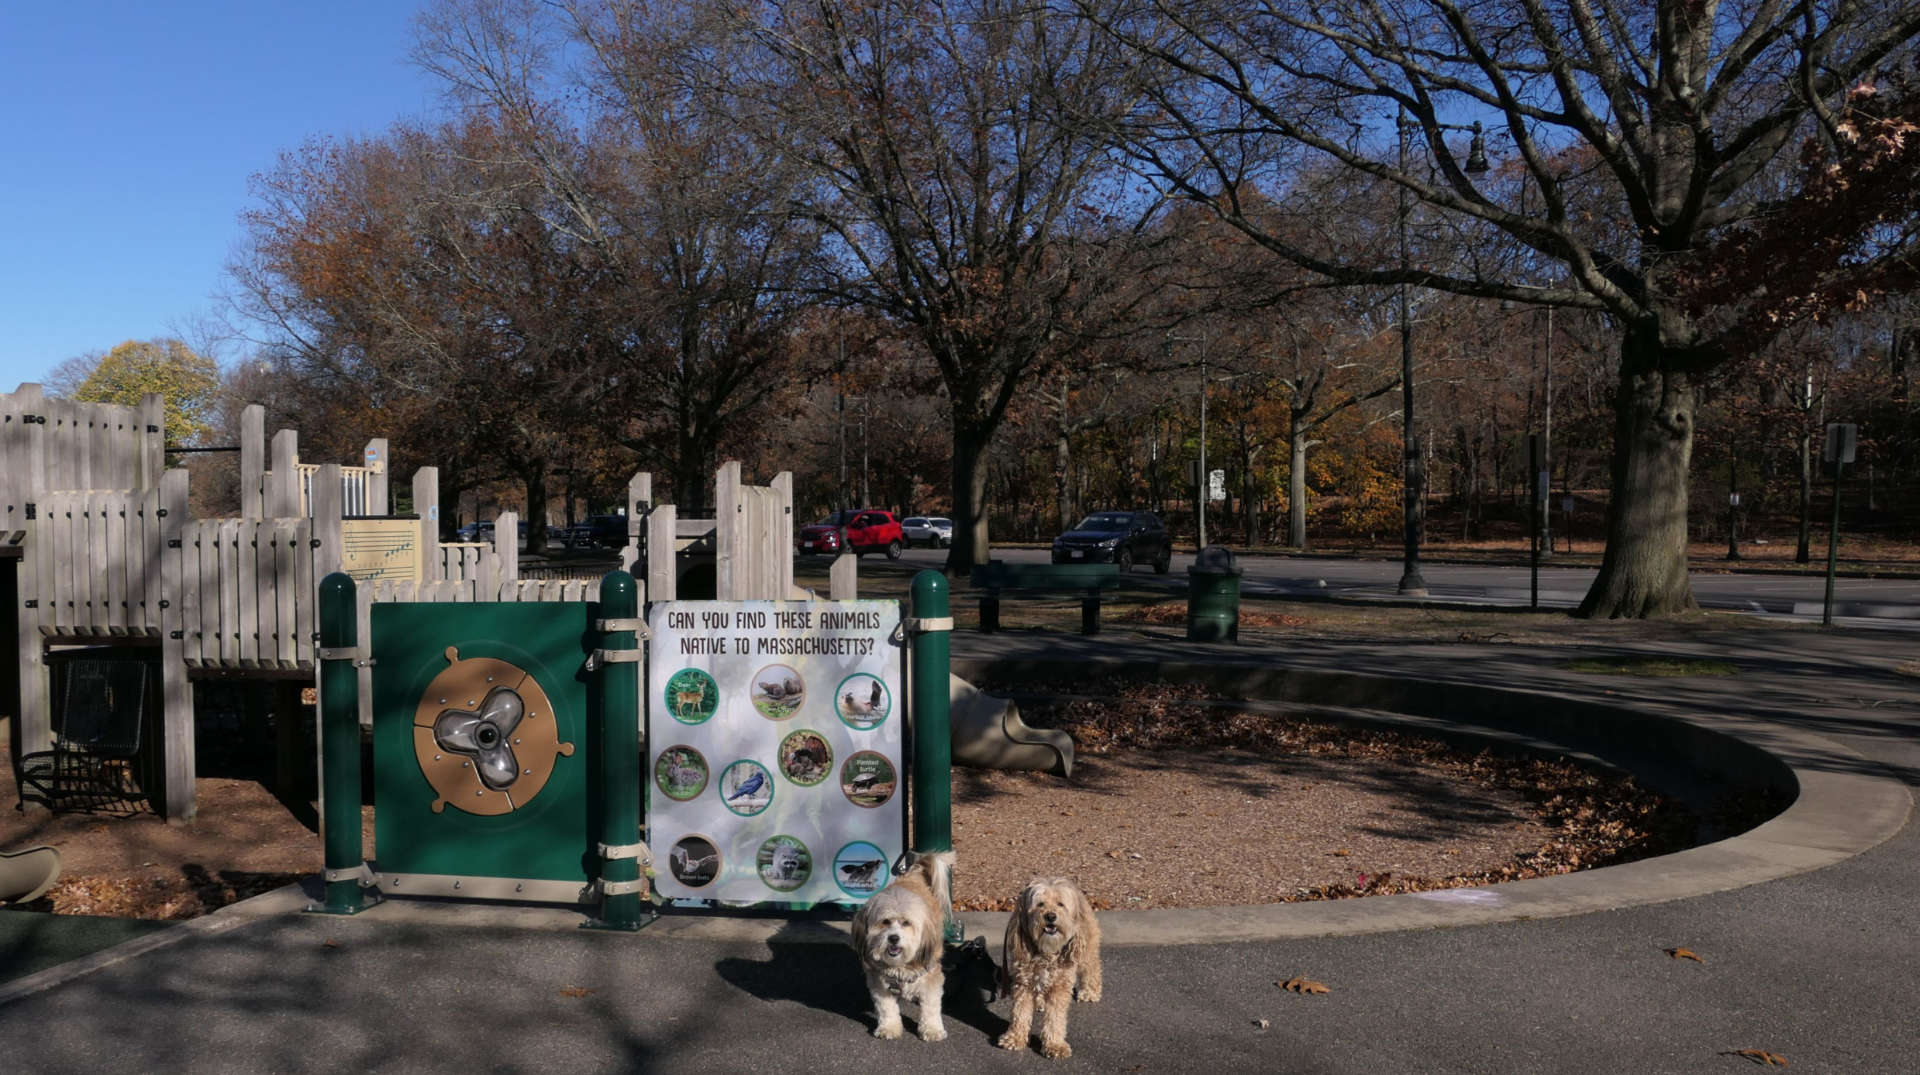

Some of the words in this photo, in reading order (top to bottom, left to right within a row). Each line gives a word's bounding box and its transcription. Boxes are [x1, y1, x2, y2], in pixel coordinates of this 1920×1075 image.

[668, 612, 695, 630] CAN
[702, 612, 729, 629] YOU
[736, 612, 766, 629] FIND
[774, 612, 812, 629] THESE
[820, 612, 880, 629] ANIMALS
[681, 638, 727, 655] NATIVE
[735, 638, 750, 655] TO
[758, 637, 875, 656] MASSACHUSETTS?
